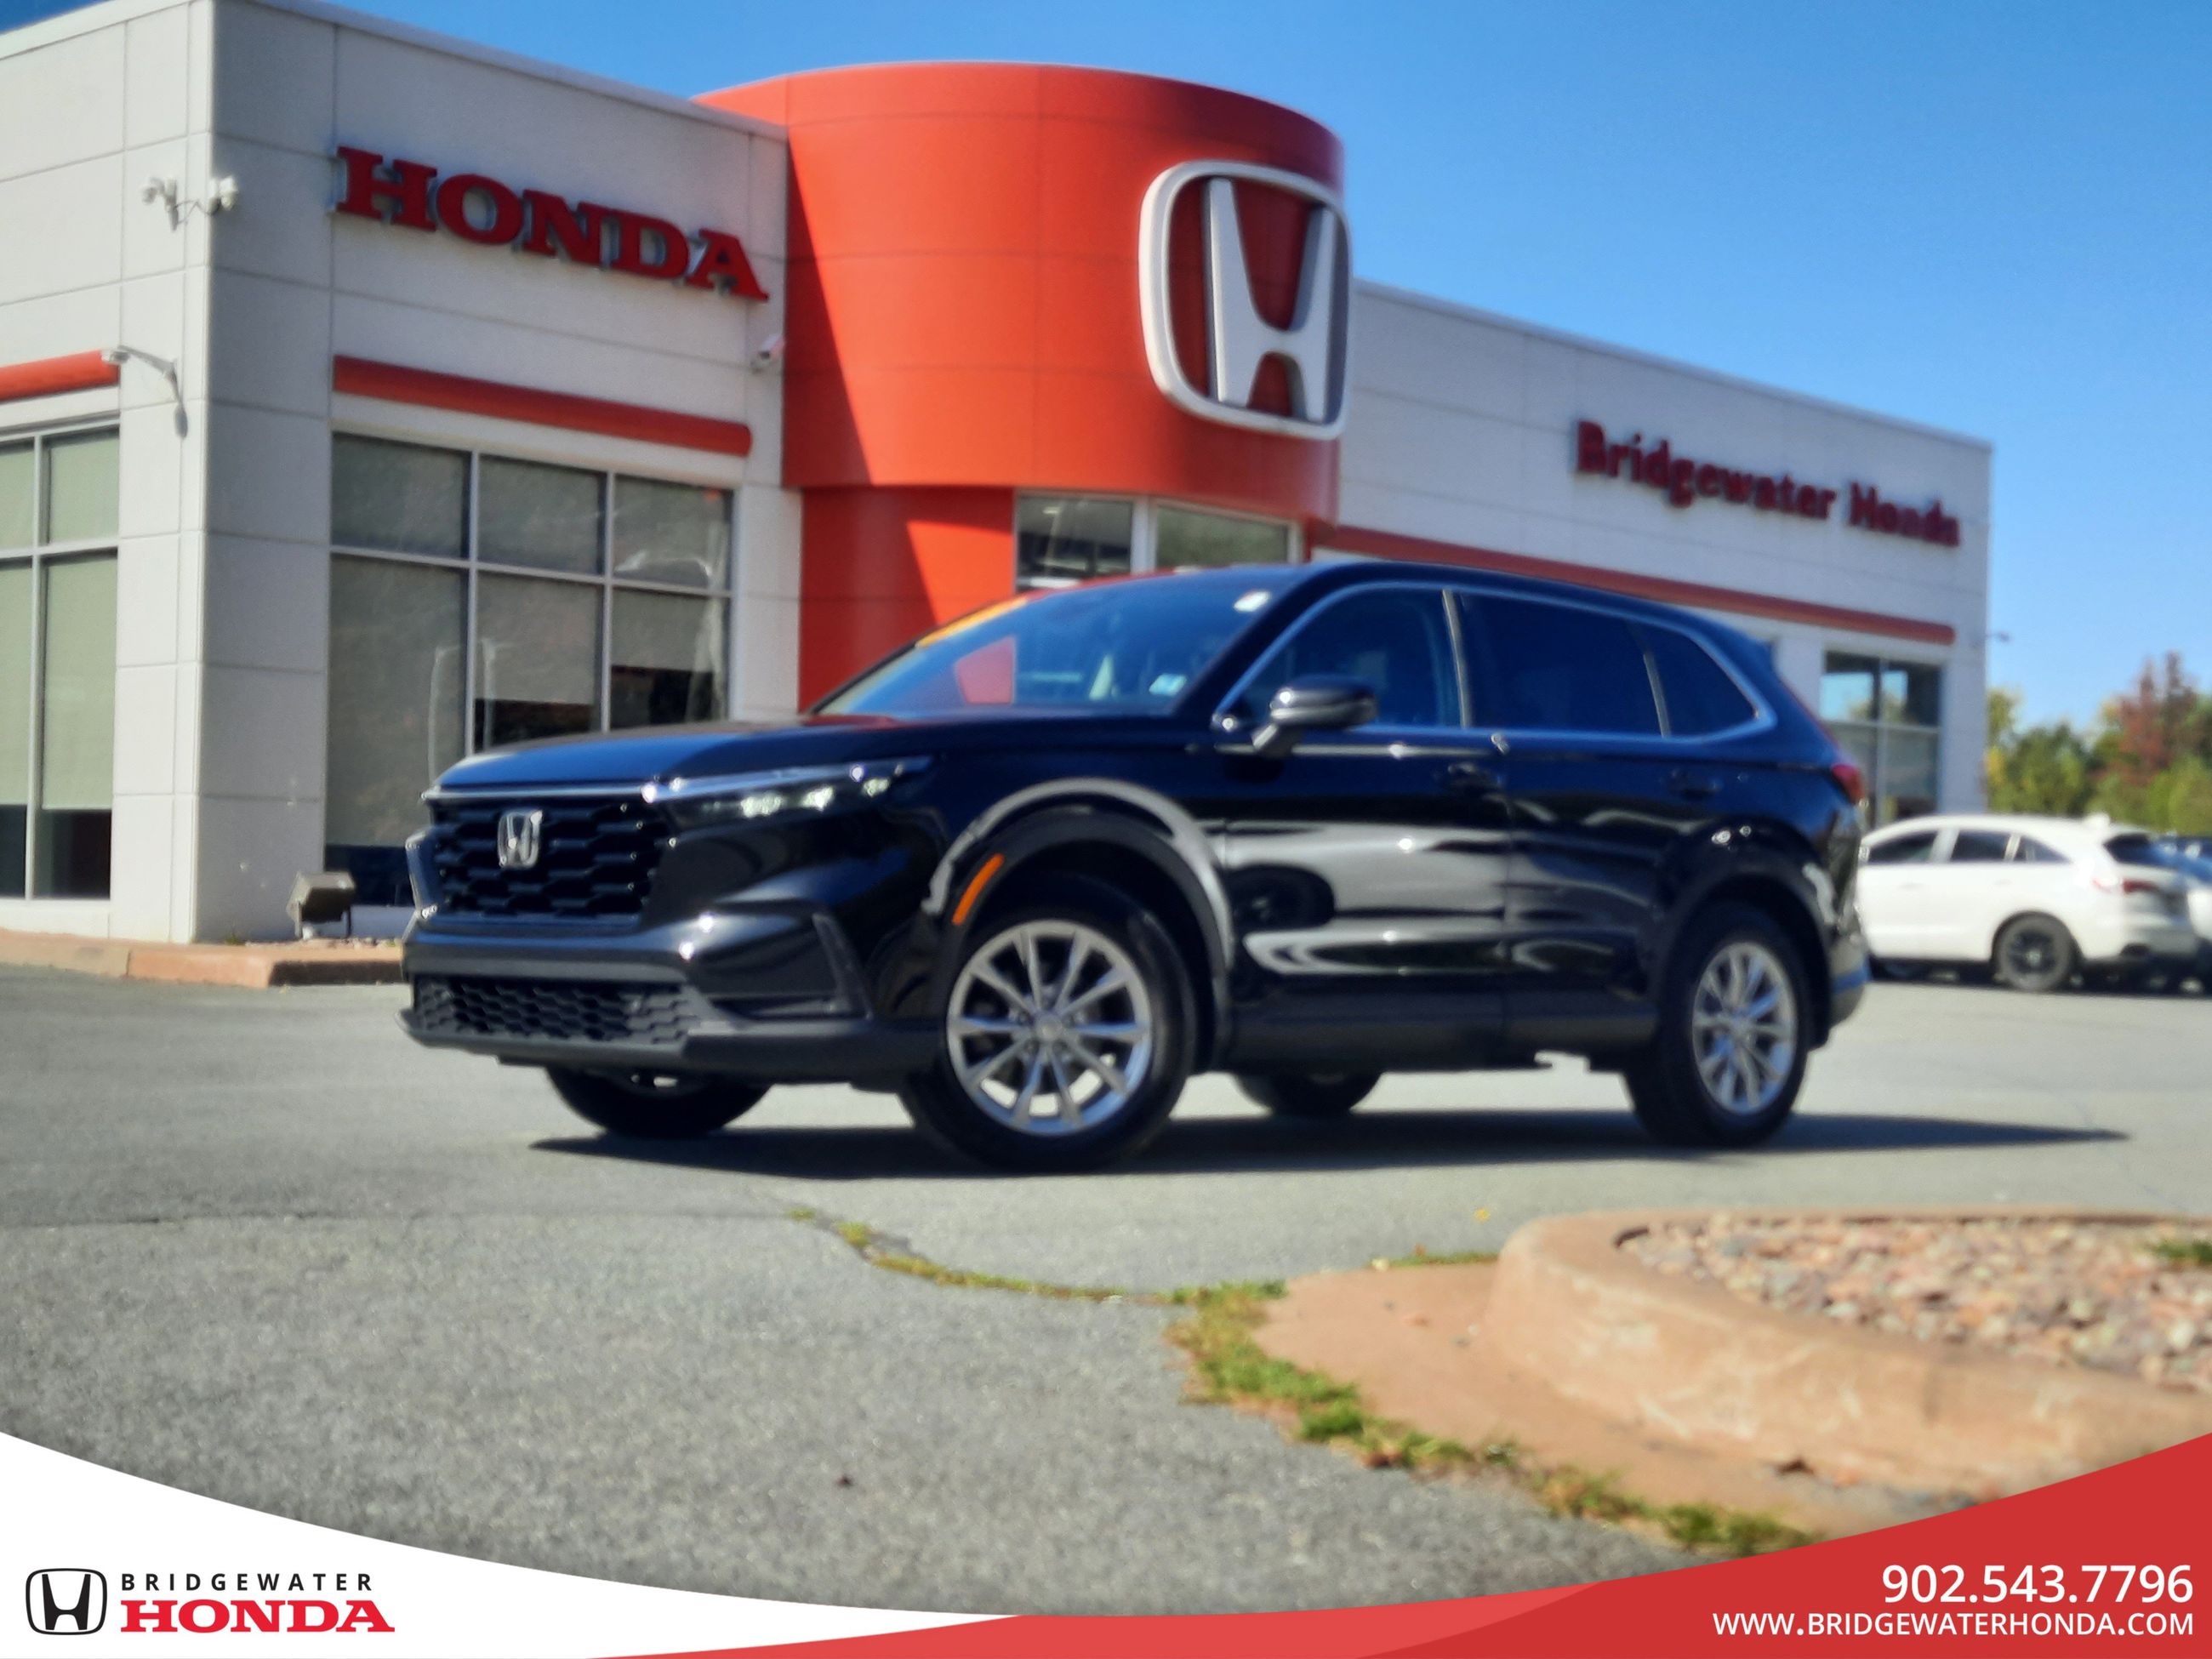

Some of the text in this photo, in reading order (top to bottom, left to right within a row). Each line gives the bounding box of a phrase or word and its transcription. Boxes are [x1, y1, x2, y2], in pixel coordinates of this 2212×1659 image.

[336, 145, 769, 301] HONDA
[1576, 419, 1961, 547] Bridgewater Honda
